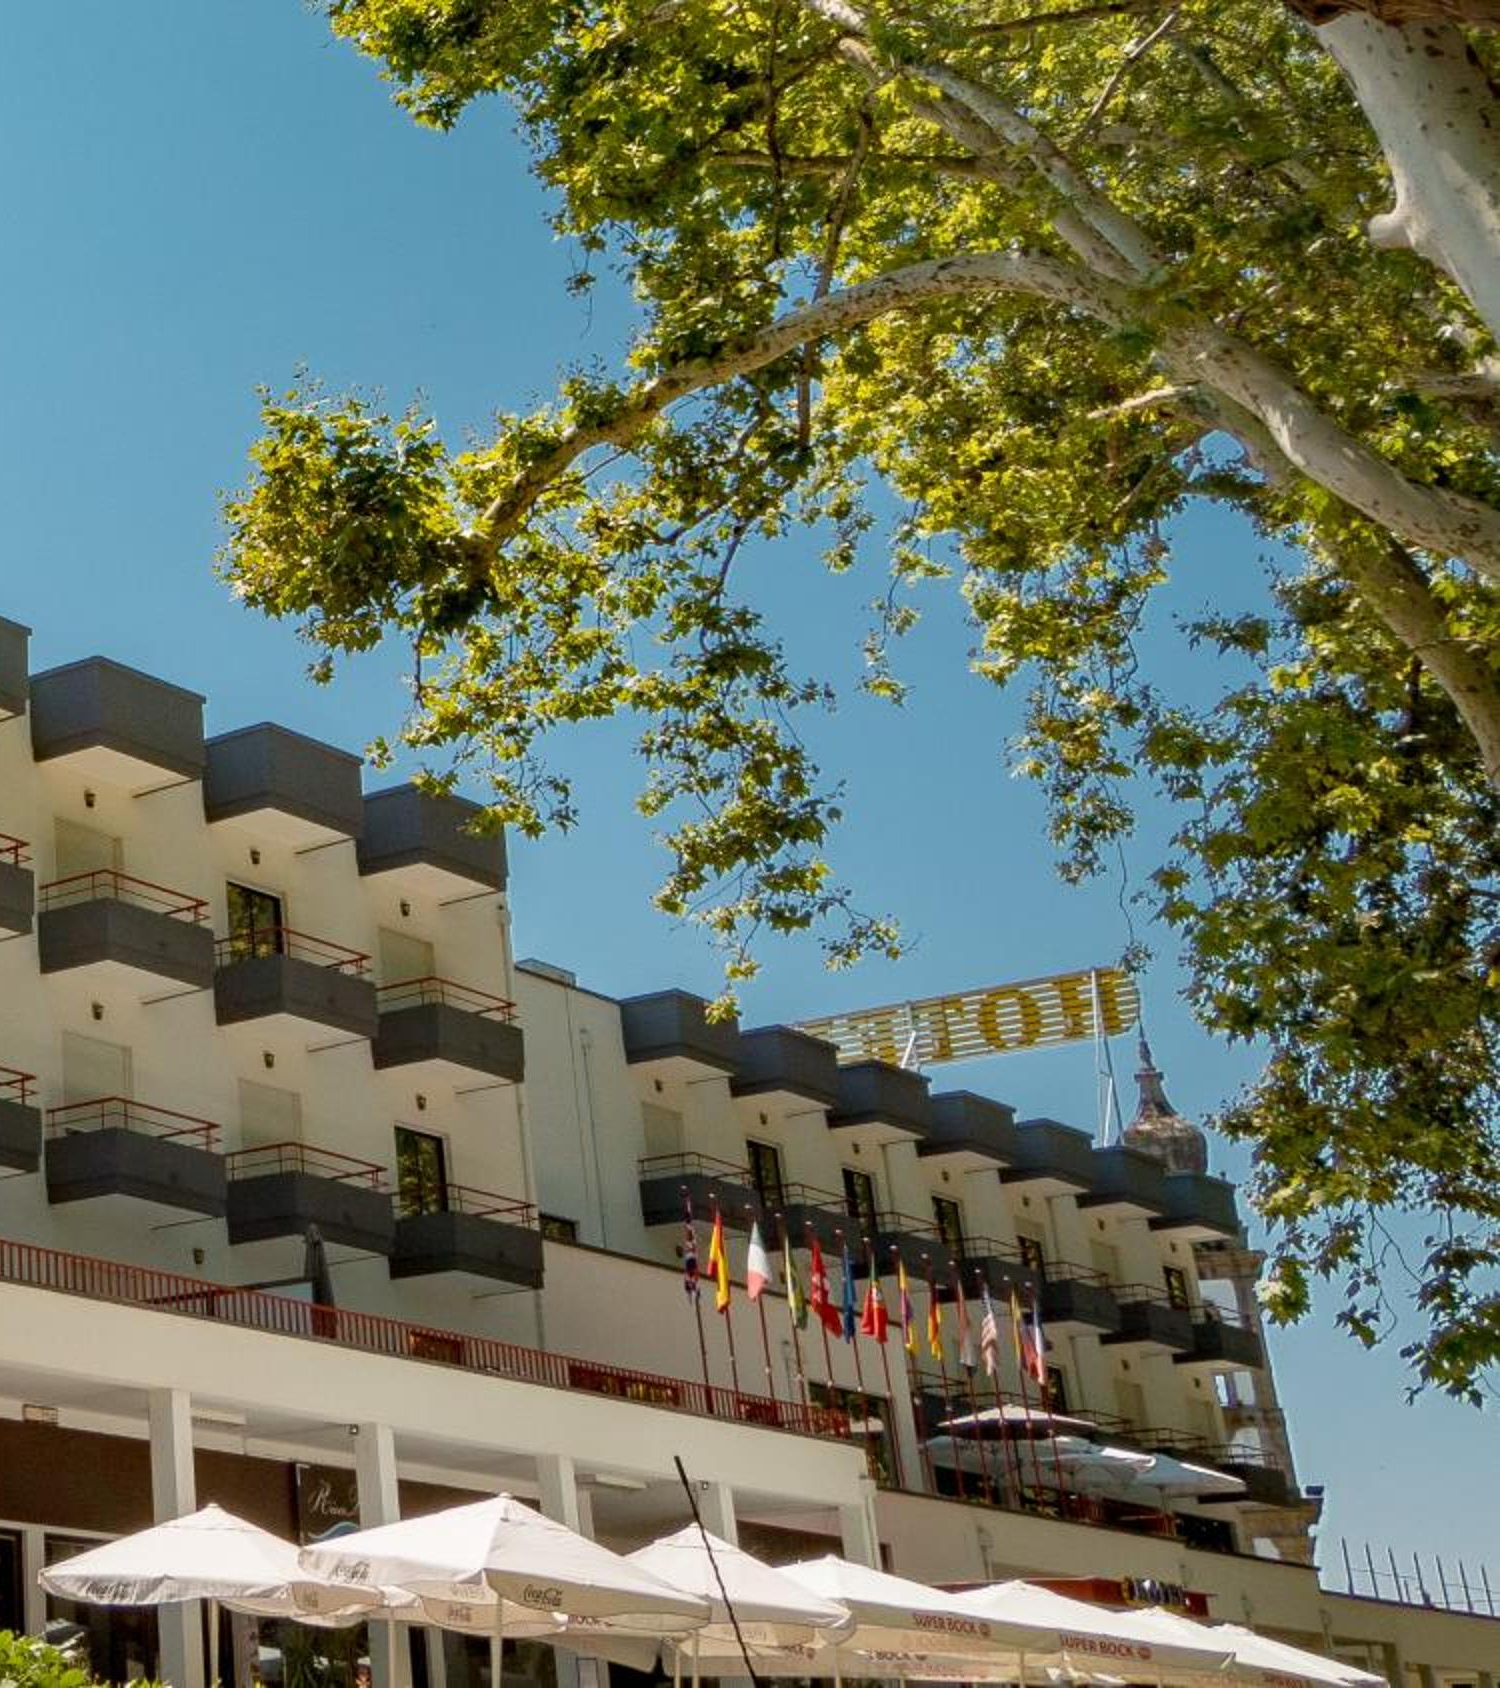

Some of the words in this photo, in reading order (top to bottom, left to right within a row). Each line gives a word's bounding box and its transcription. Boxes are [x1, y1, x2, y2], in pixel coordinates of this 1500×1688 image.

[912, 1611, 947, 1632] SUPER
[947, 1617, 979, 1635] BOCK
[1060, 1636, 1097, 1654] SUPER
[1099, 1641, 1134, 1658] BOCK
